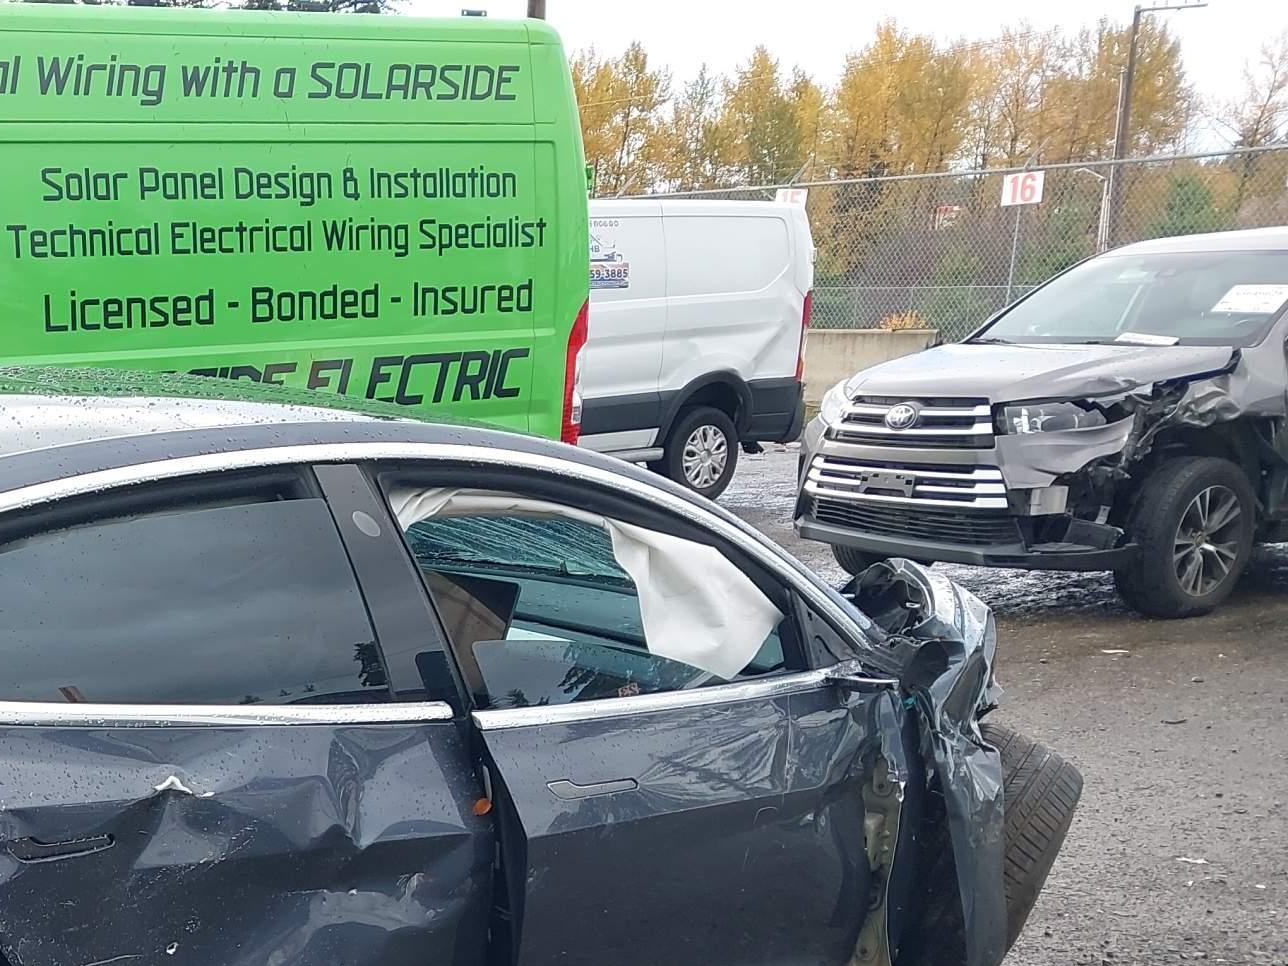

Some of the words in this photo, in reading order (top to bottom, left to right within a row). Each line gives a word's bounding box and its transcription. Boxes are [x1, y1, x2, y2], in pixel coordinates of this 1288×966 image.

[37, 54, 166, 106] Wiring
[181, 57, 260, 98] with
[273, 67, 296, 98] a
[308, 62, 520, 101] SOLARSIDE
[41, 167, 128, 201] Solar
[139, 167, 224, 200] Panel
[234, 165, 332, 206] Design
[343, 167, 360, 200] &
[370, 165, 516, 199] Installation
[1010, 173, 1037, 203] 16
[6, 220, 160, 258] Technical
[171, 218, 312, 255] Electrical
[322, 217, 409, 257] Wiring
[419, 216, 547, 256] Specialist
[44, 289, 214, 332] Licensed
[251, 283, 379, 323] Bonded
[413, 278, 533, 316] Insured
[307, 347, 530, 405] ELECTRIC
